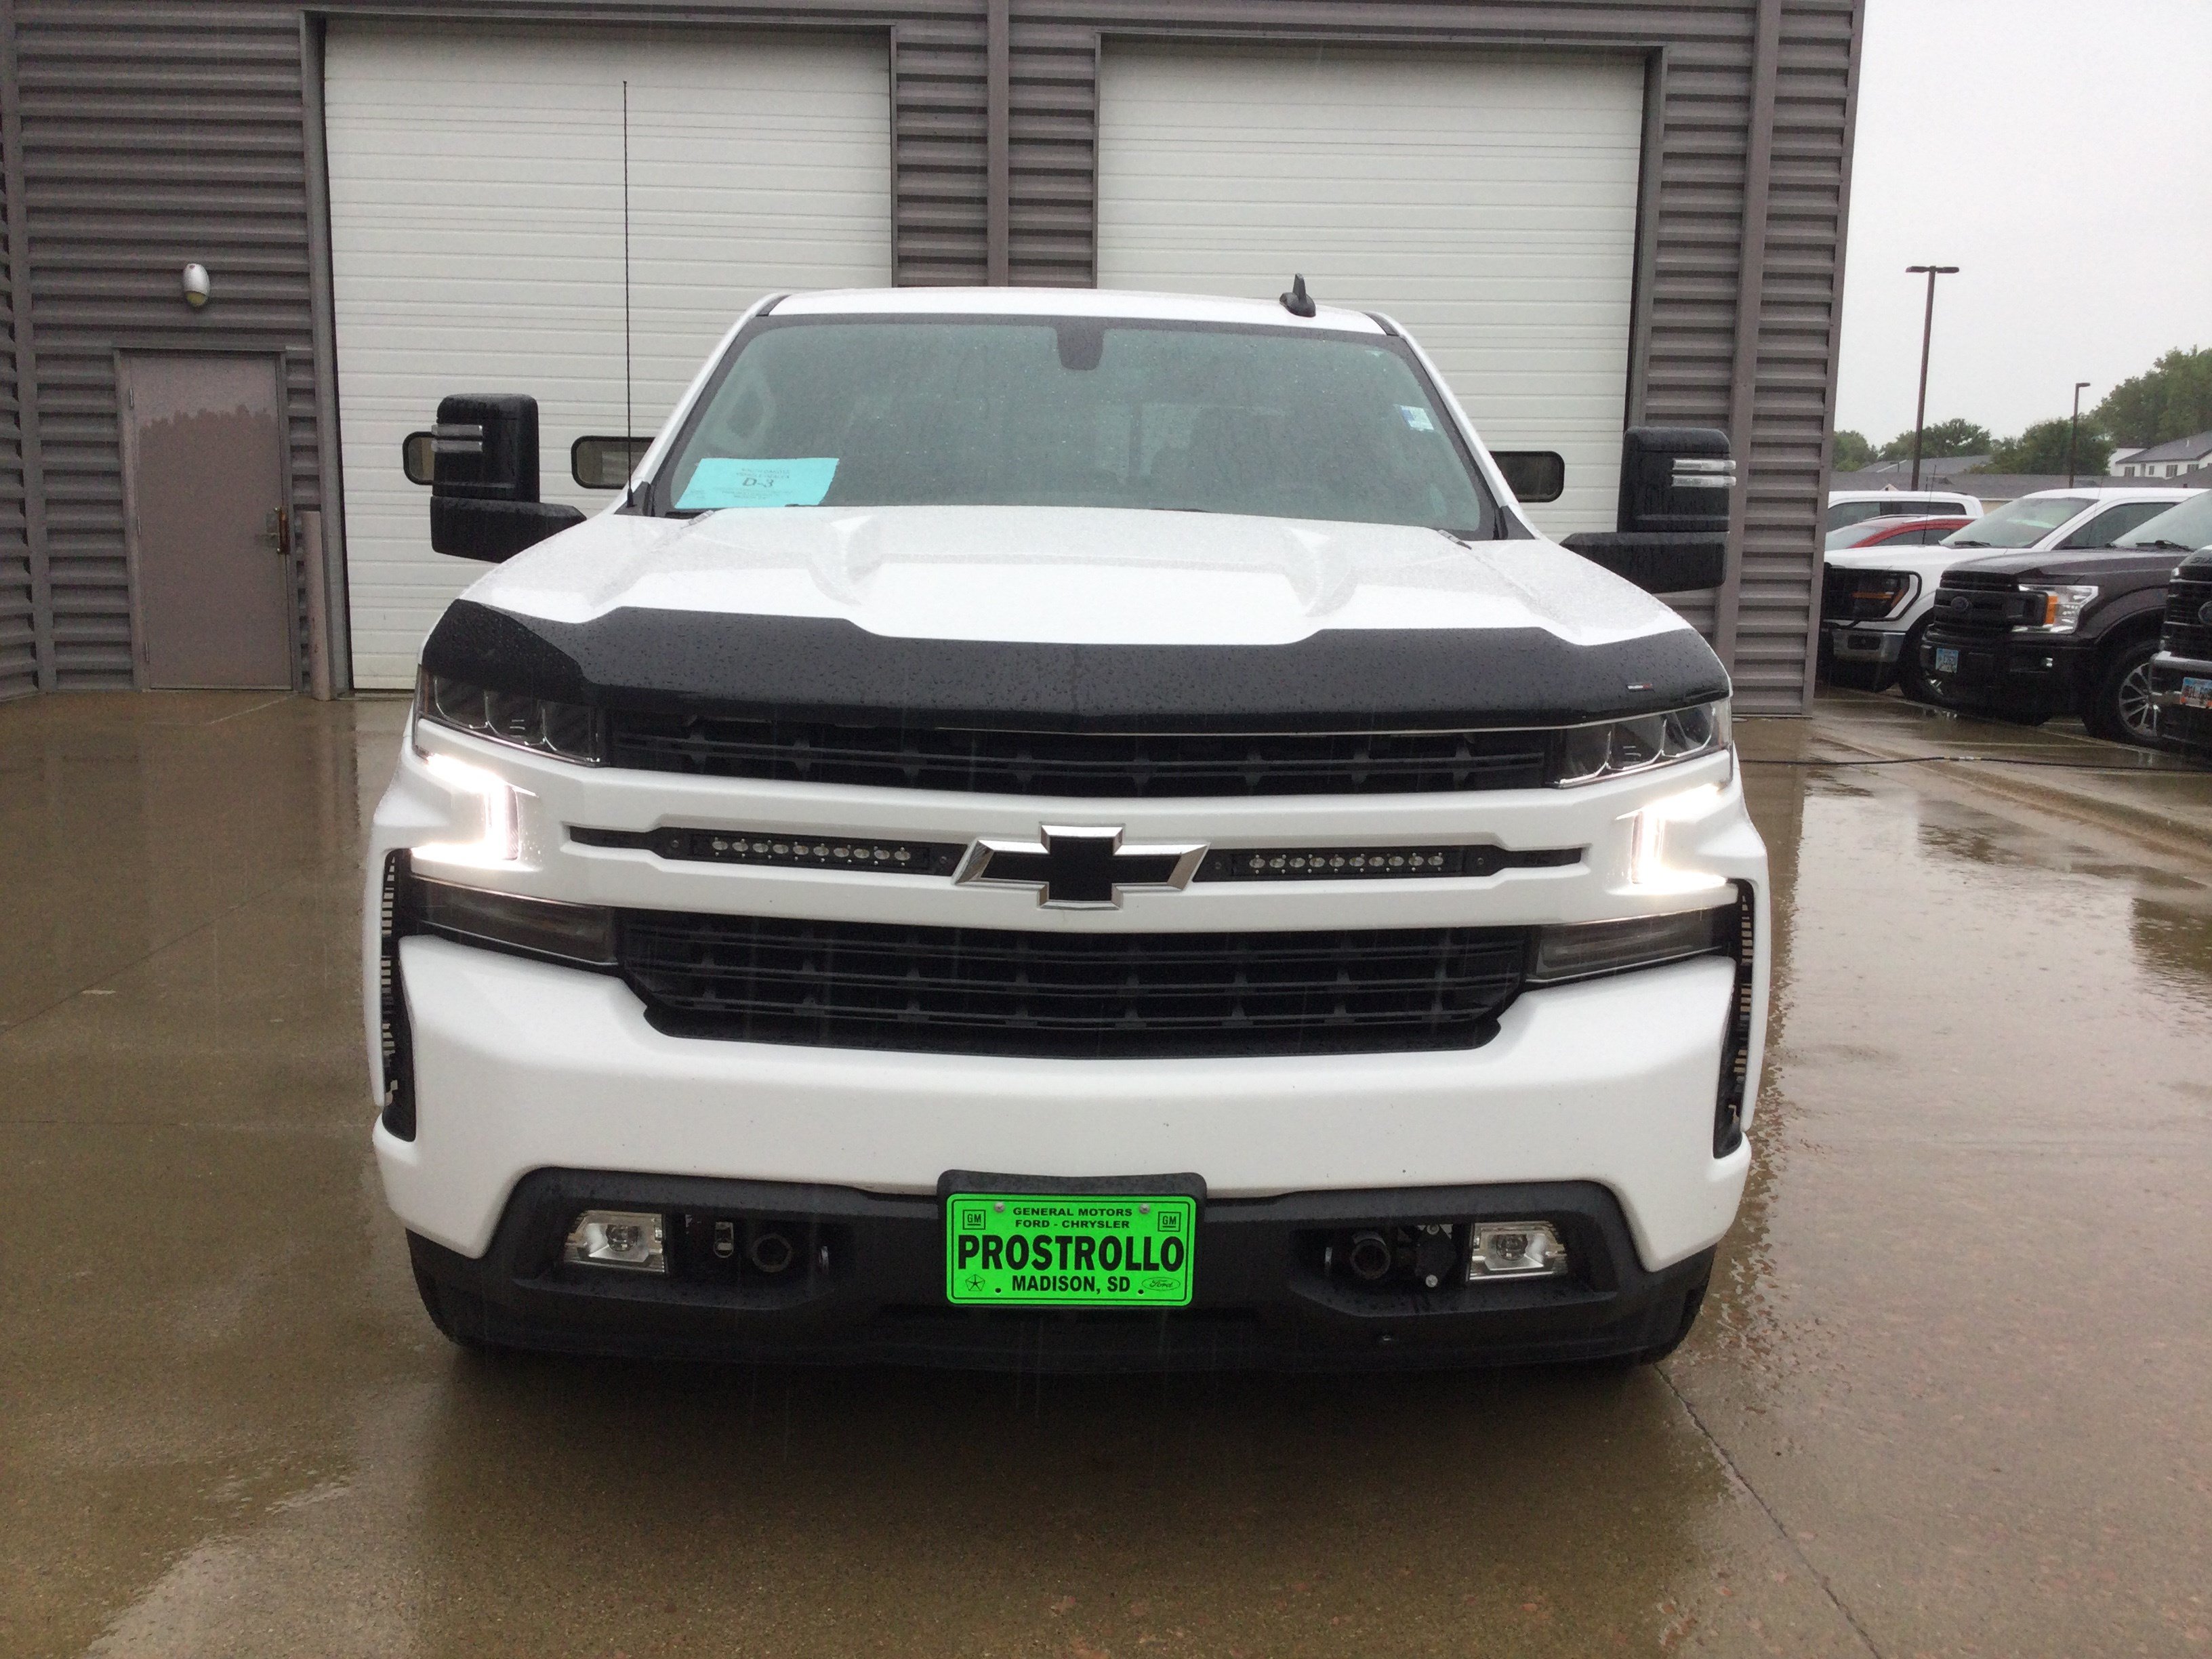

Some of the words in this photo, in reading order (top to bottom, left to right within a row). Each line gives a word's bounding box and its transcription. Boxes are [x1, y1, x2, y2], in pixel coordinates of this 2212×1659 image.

[1012, 1207, 1074, 1217] GENERAL
[1078, 1208, 1133, 1218] MOTORS
[966, 1213, 982, 1223] GM
[1162, 1215, 1177, 1225] GM
[1015, 1219, 1050, 1229] FORD
[1061, 1220, 1130, 1229] CHRYSLER
[958, 1234, 1185, 1272] PROSTROLLO
[1012, 1275, 1101, 1294] MADISON,
[1107, 1276, 1131, 1293] SD
[1149, 1279, 1173, 1288] Ford
